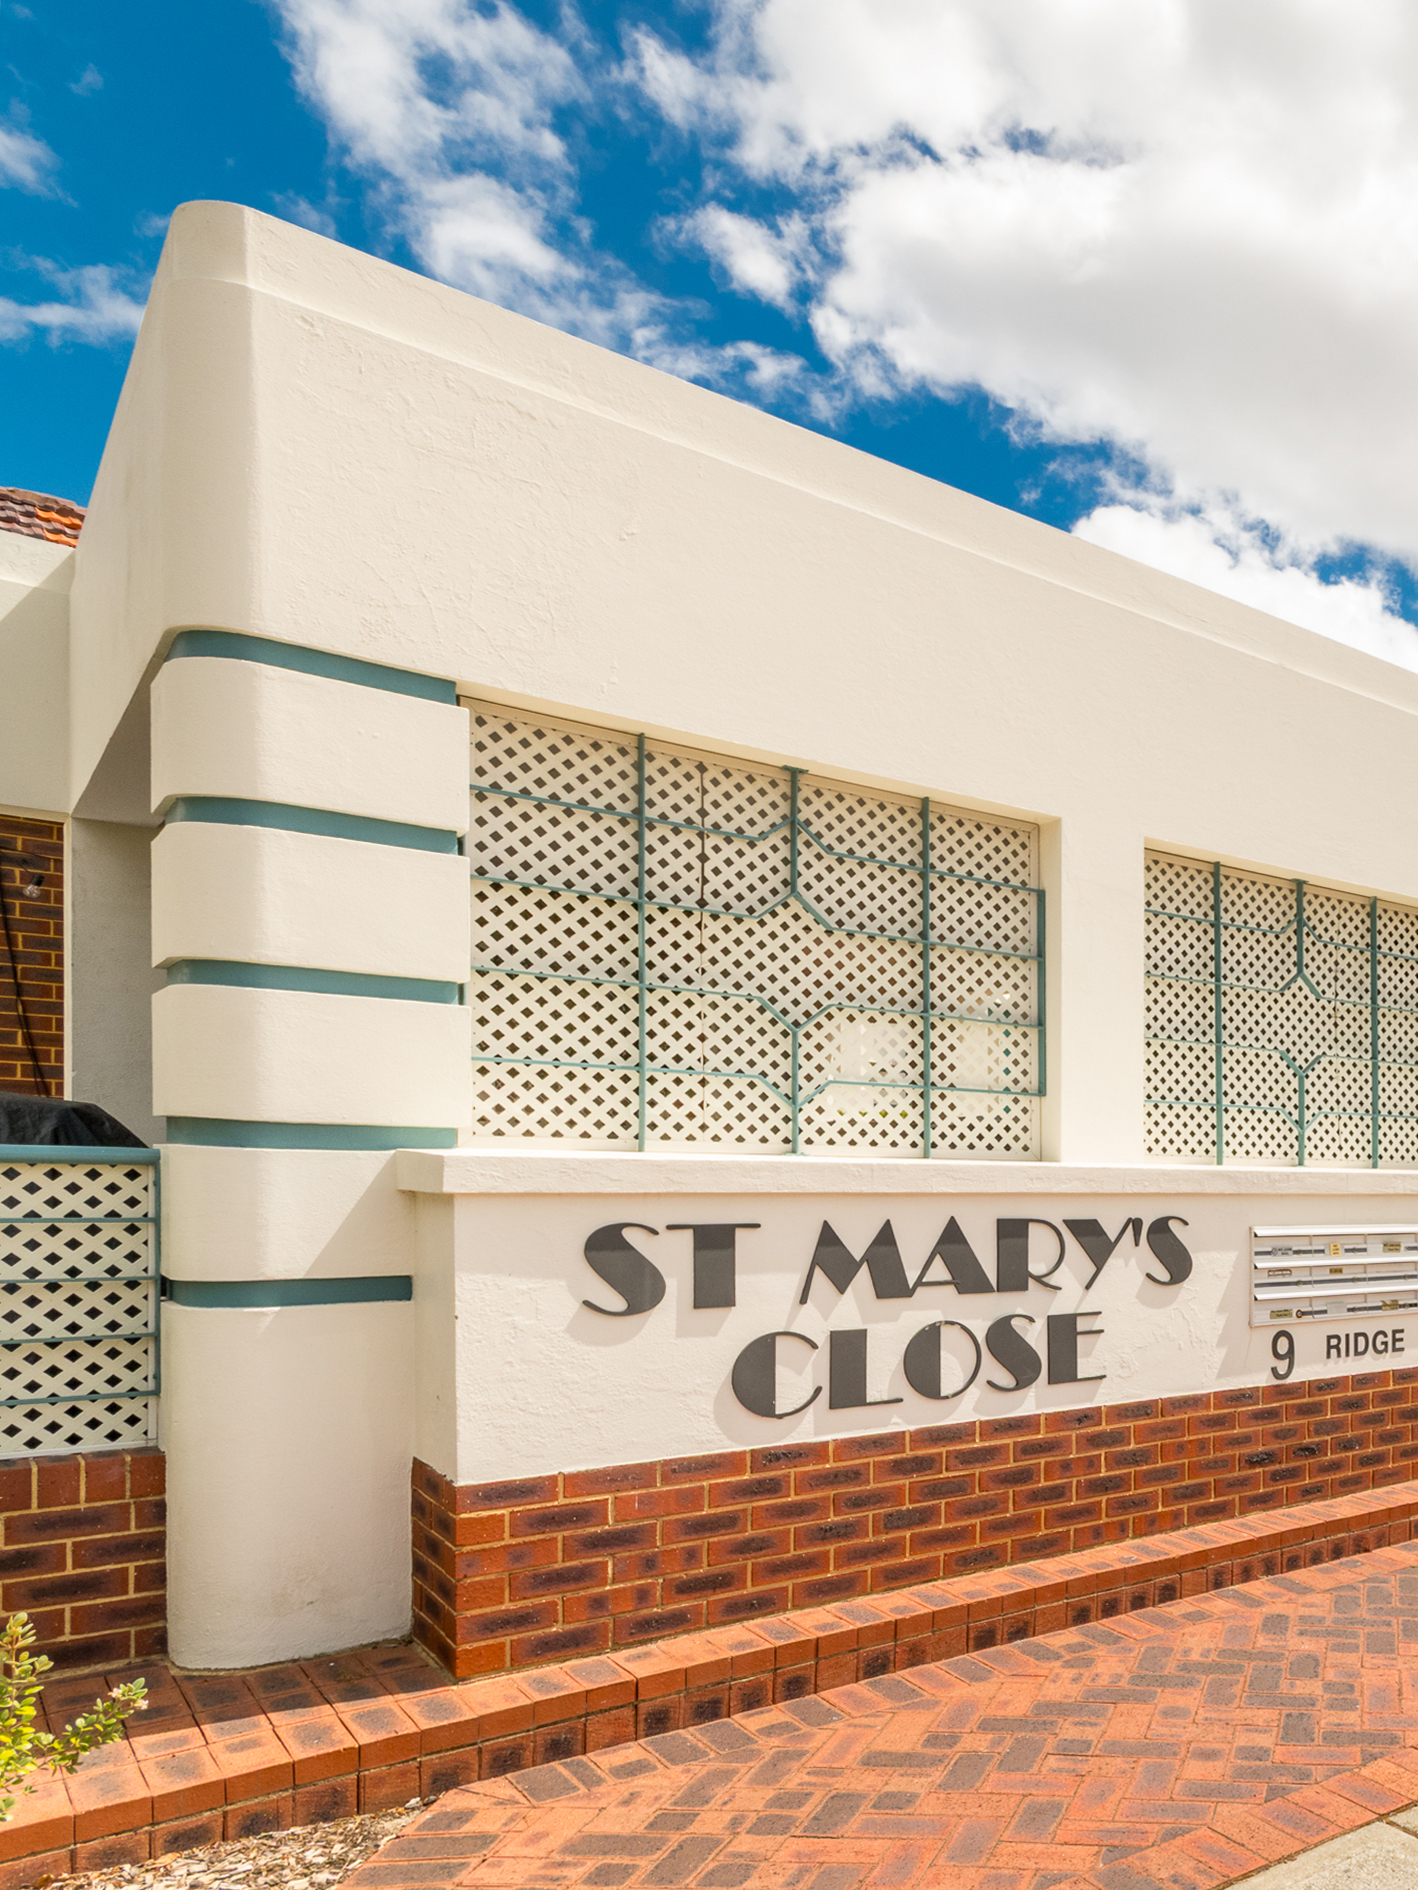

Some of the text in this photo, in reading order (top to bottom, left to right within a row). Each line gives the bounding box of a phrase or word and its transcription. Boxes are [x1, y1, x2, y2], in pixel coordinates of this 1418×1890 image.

[583, 1216, 1194, 1317] ST MARY'S
[731, 1312, 1106, 1419] CLOSE
[1270, 1329, 1295, 1380] 9
[1326, 1328, 1405, 1359] RIDGE
